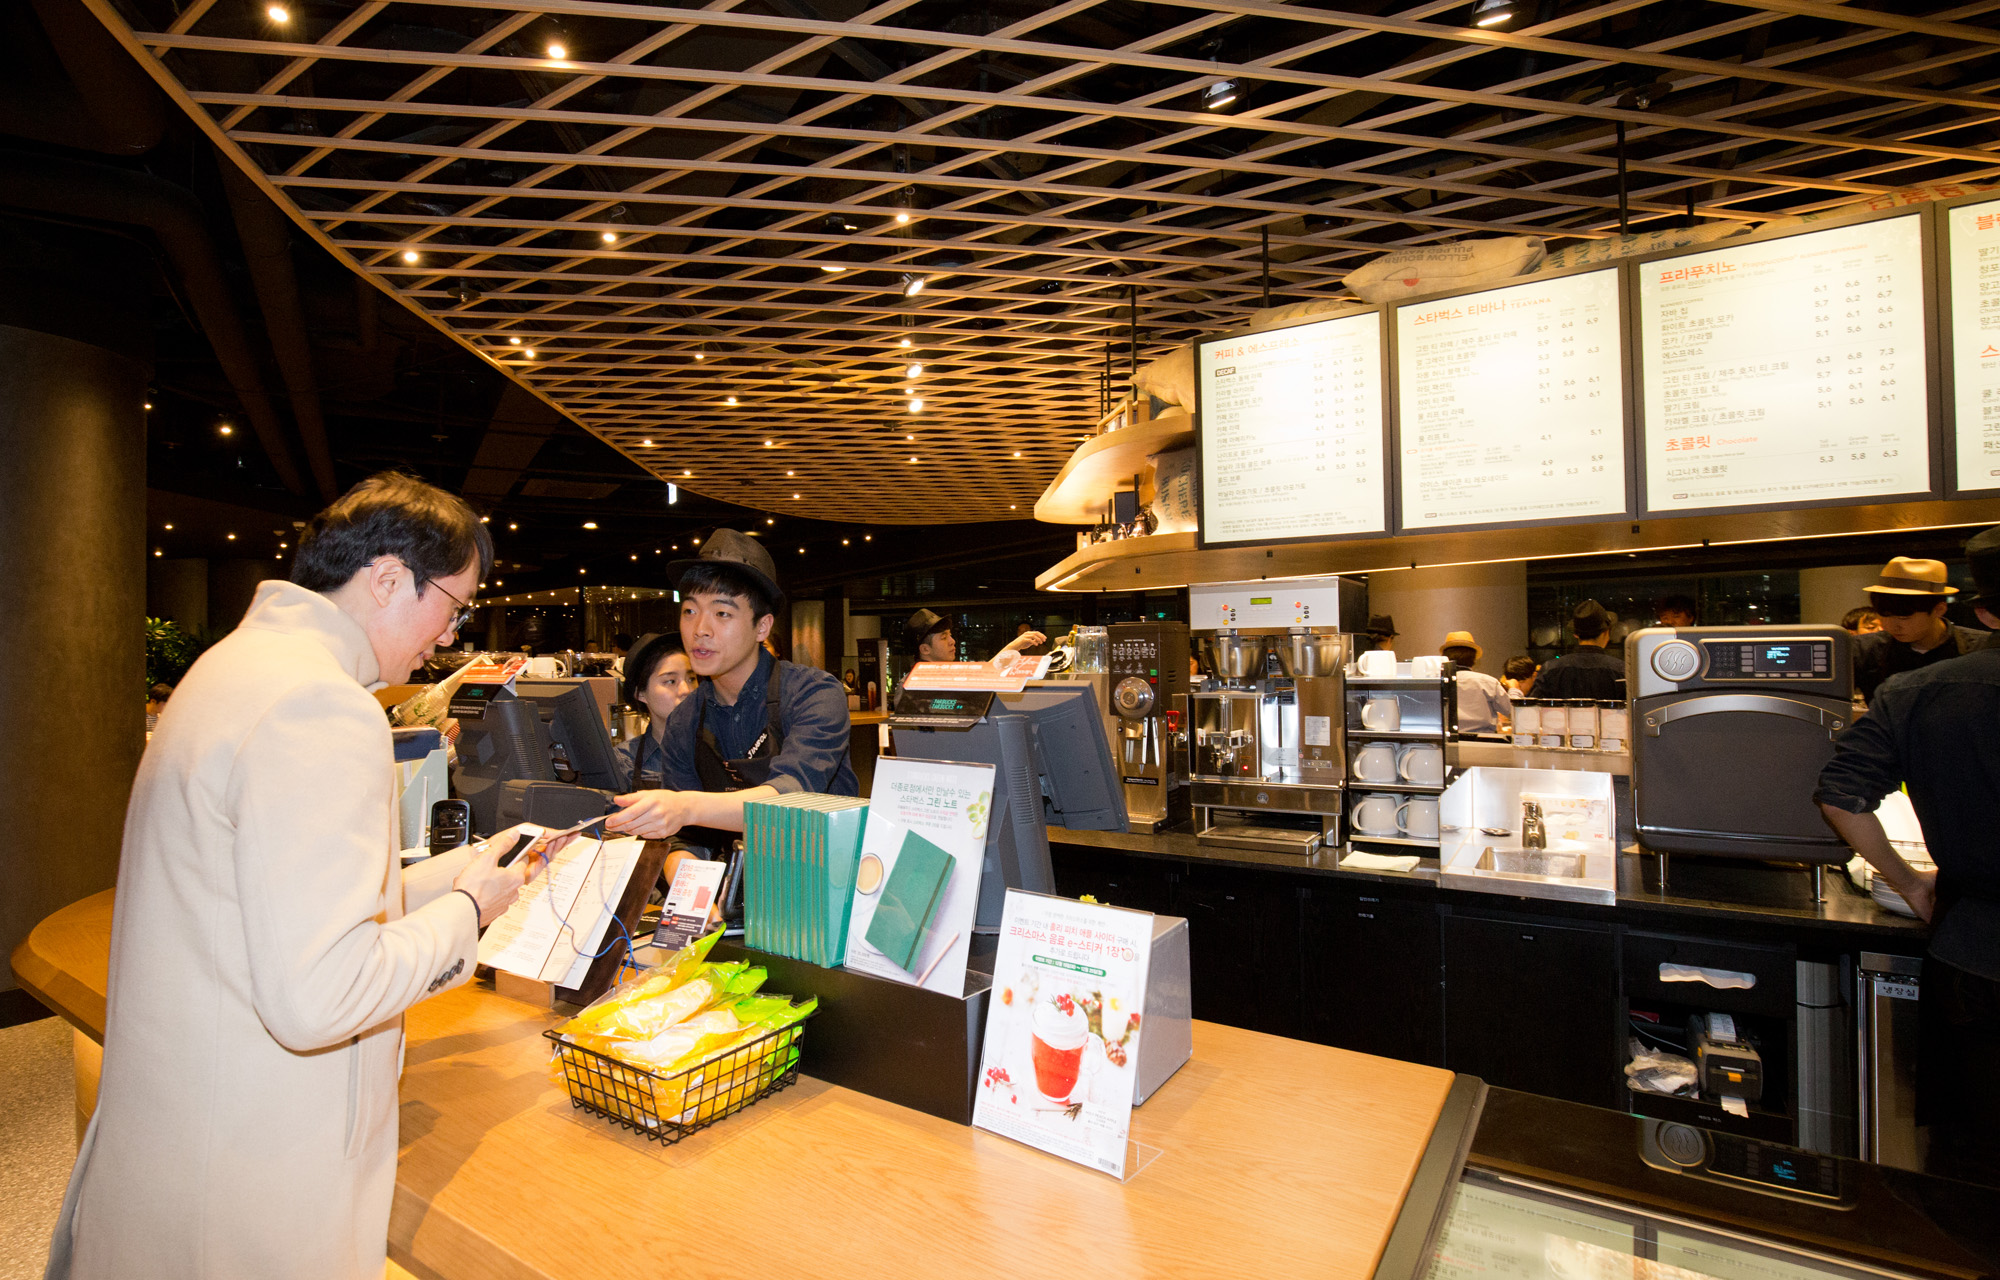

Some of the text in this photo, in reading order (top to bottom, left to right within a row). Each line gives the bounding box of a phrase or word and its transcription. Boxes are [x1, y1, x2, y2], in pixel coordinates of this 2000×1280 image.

[1976, 213, 2000, 230] 블
[1659, 261, 1736, 284] 프라푸치노
[1413, 298, 1551, 326] 스타벅스 티바나 TEAVANA
[1661, 322, 1685, 331] 화이트
[1215, 348, 1234, 359] 커피
[1237, 347, 1244, 356] &
[1662, 348, 1704, 359] 에스프레소
[1216, 367, 1235, 376] DECAF
[1665, 435, 1758, 451] 초콜릿 Chocolate
[1667, 465, 1727, 476] 시그니처 초콜릿
[891, 783, 971, 799] 더종로점에서만 만날수 있는
[900, 795, 957, 809] 스타벅스 그린 노트
[1050, 923, 1062, 932] 홀리
[1065, 926, 1077, 935] 피치
[1080, 929, 1092, 938] 애플
[1095, 932, 1114, 943] 사이더
[1009, 926, 1120, 958] 크리스마스 음료 e-스티커 1장
[1883, 986, 1916, 997] 냉장실
